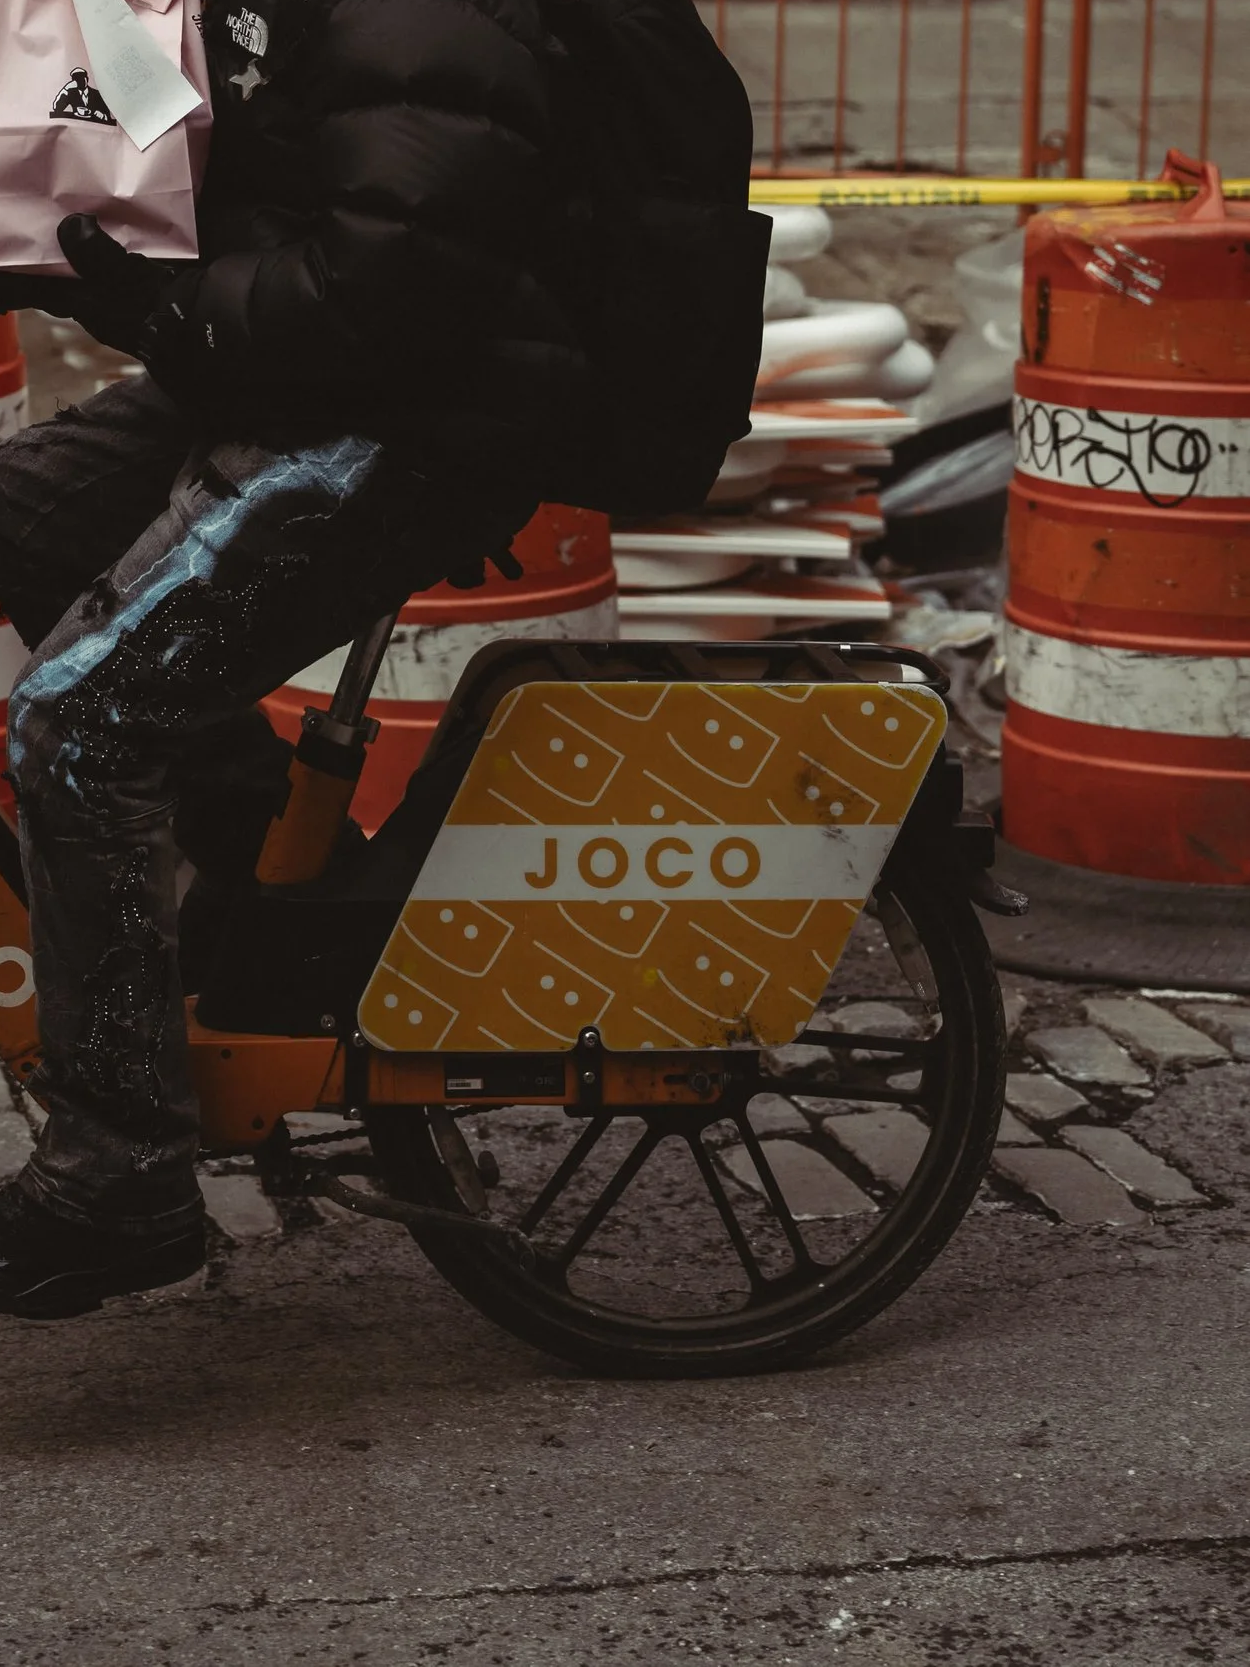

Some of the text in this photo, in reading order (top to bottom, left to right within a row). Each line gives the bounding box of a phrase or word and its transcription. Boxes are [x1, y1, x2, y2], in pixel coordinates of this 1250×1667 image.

[226, 13, 253, 38] NORTH
[240, 7, 256, 26] THE
[232, 28, 251, 50] FACE
[524, 836, 761, 889] JOCO
